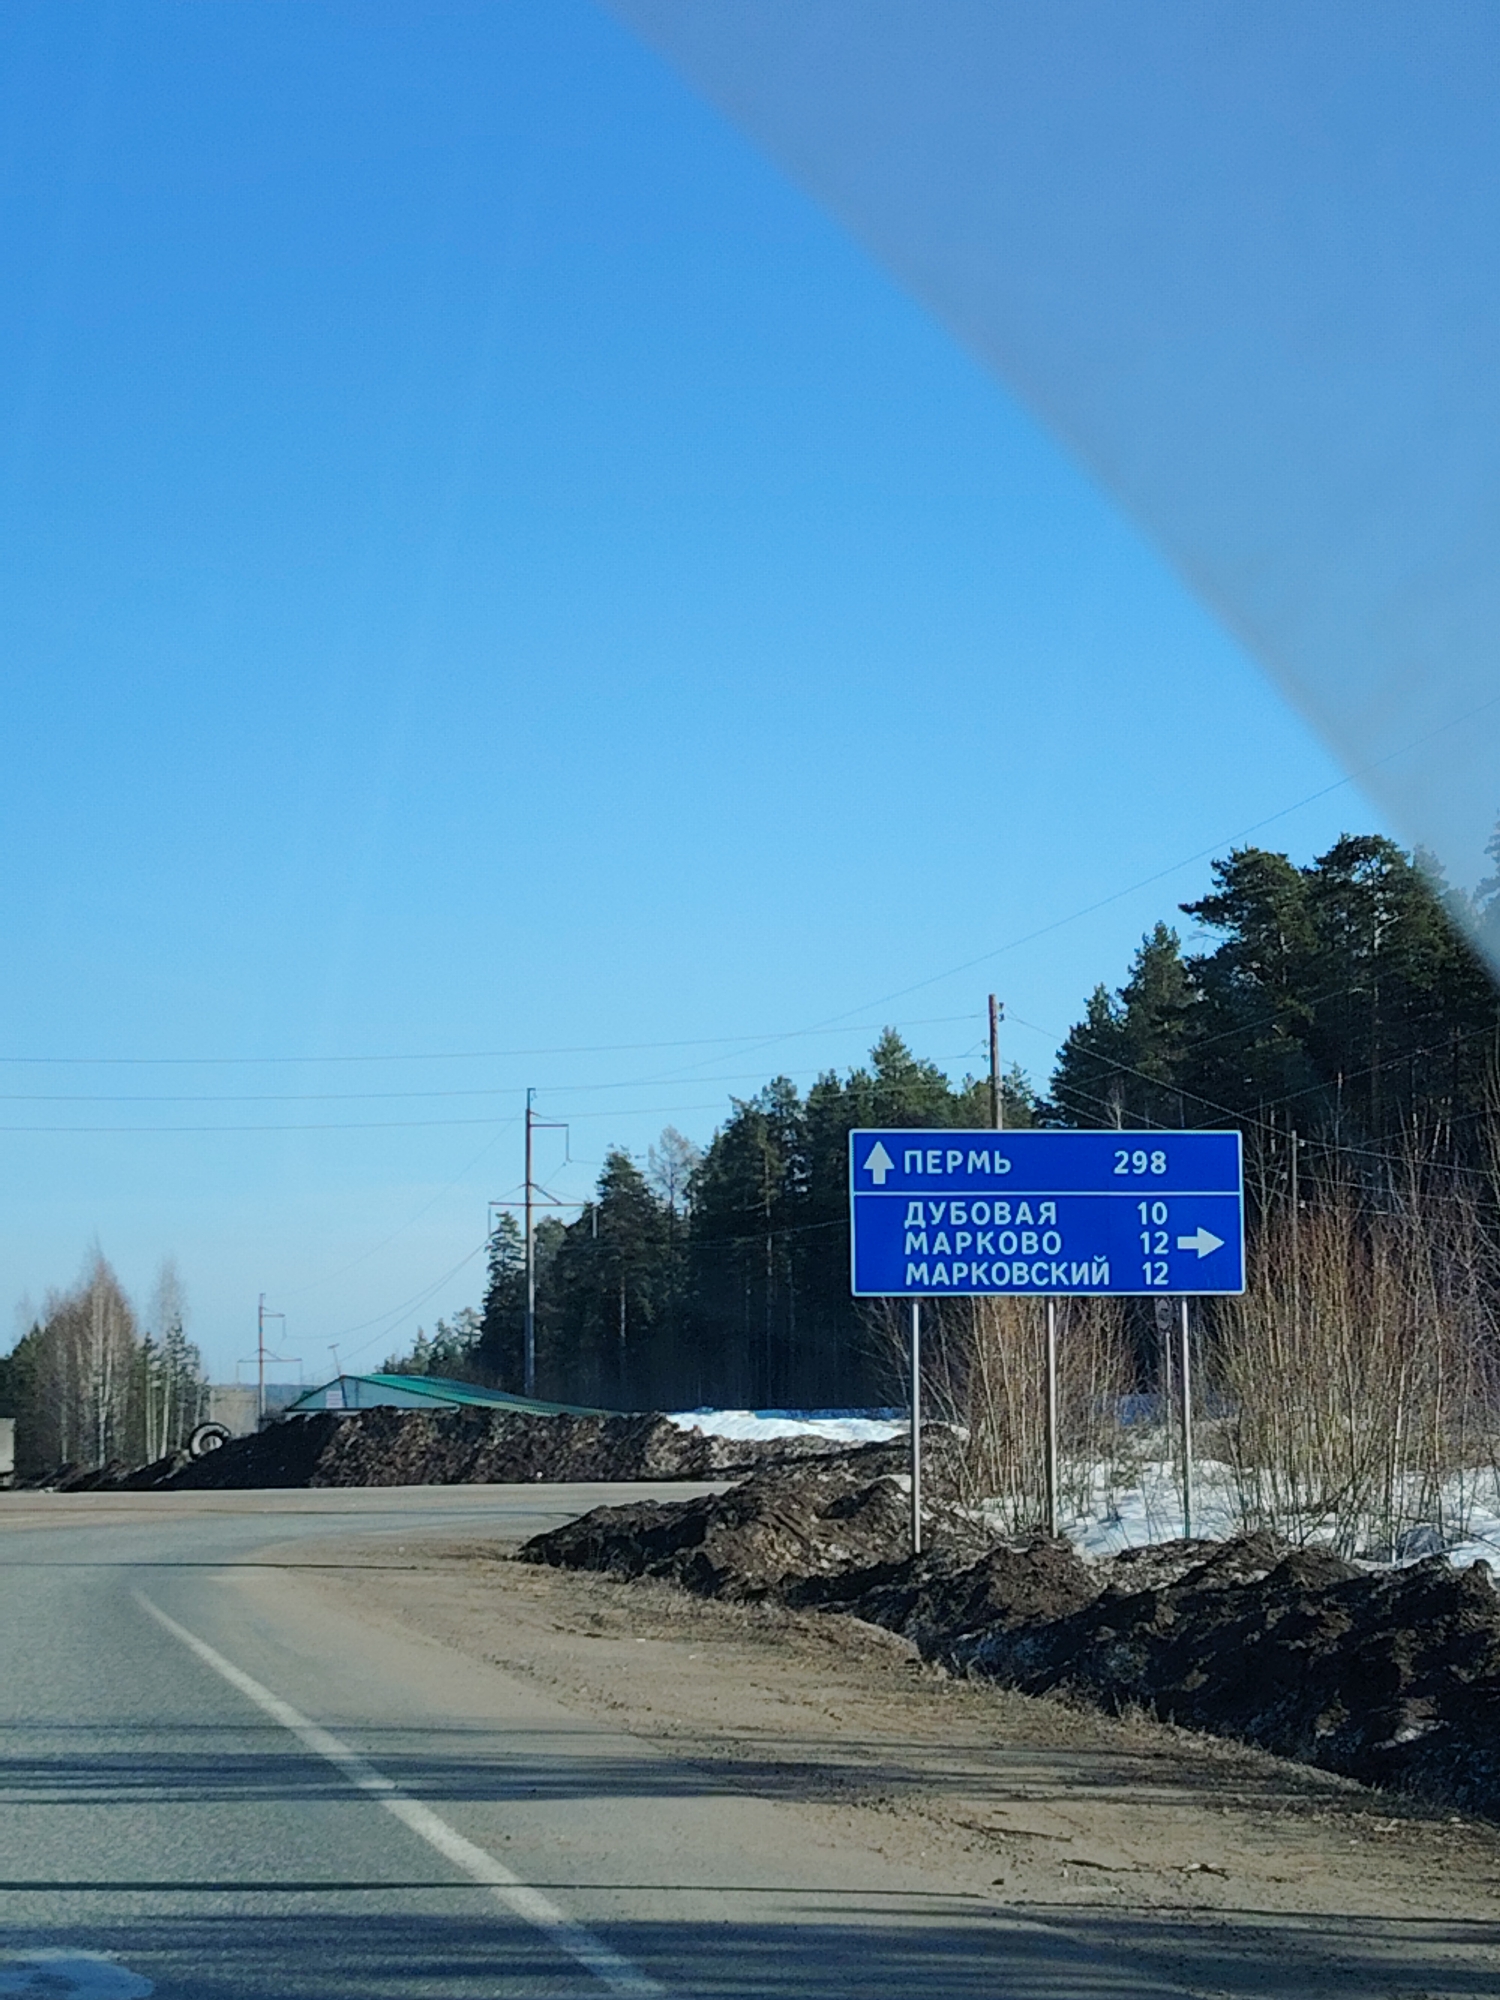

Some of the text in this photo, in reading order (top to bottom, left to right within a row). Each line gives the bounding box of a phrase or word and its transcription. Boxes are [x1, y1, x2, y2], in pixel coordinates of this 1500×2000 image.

[904, 1150, 1167, 1174] ПЕРМЬ 298
[904, 1201, 1168, 1229] ДУБОВАЯ 10
[905, 1231, 1169, 1255] МАРКОВО 12
[905, 1255, 1169, 1286] МАРКОВСКИЙ 12
